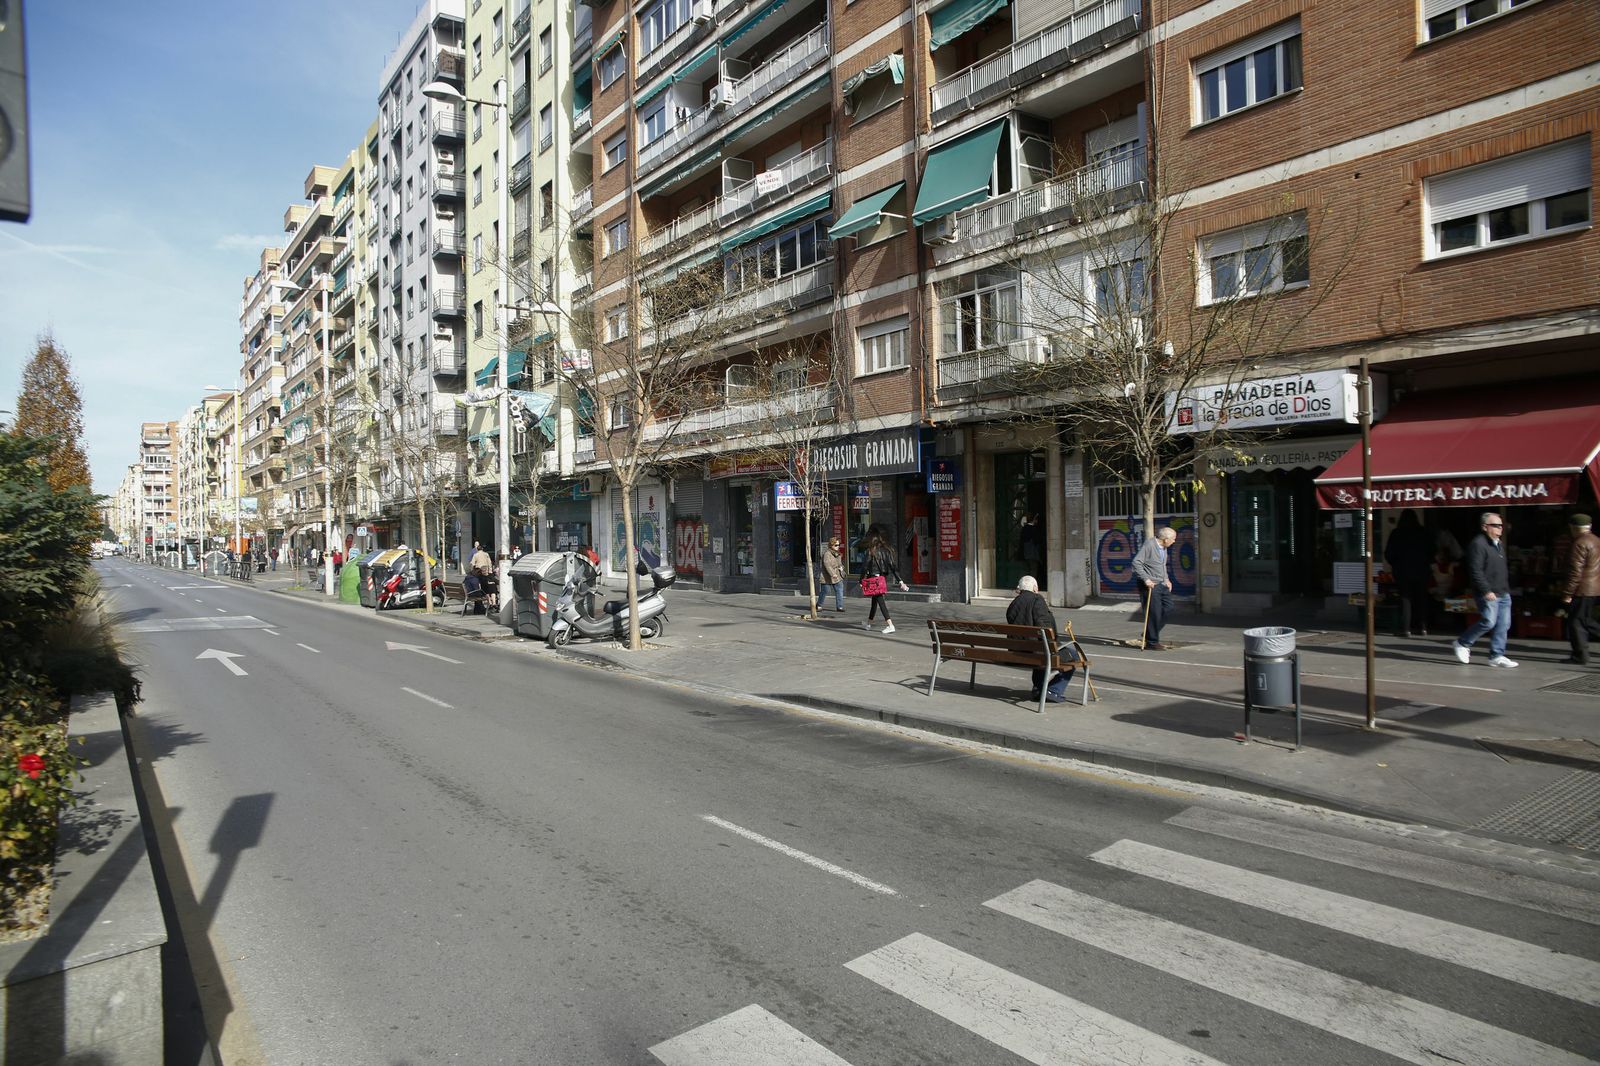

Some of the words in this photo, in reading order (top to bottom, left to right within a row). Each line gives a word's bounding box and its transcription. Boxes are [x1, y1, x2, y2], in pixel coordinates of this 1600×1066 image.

[1214, 376, 1316, 404] PANADERÍA
[1203, 408, 1215, 422] la
[1220, 403, 1265, 425] gracia
[1269, 399, 1288, 416] de
[1294, 396, 1331, 414] Dios
[814, 444, 858, 473] RIEGOSUR
[865, 437, 914, 468] GRANADA
[932, 473, 954, 481] RIEGOSUR
[932, 482, 954, 491] GRANADA
[1370, 487, 1446, 502] RUTERIA
[1452, 482, 1548, 500] ENCARNA
